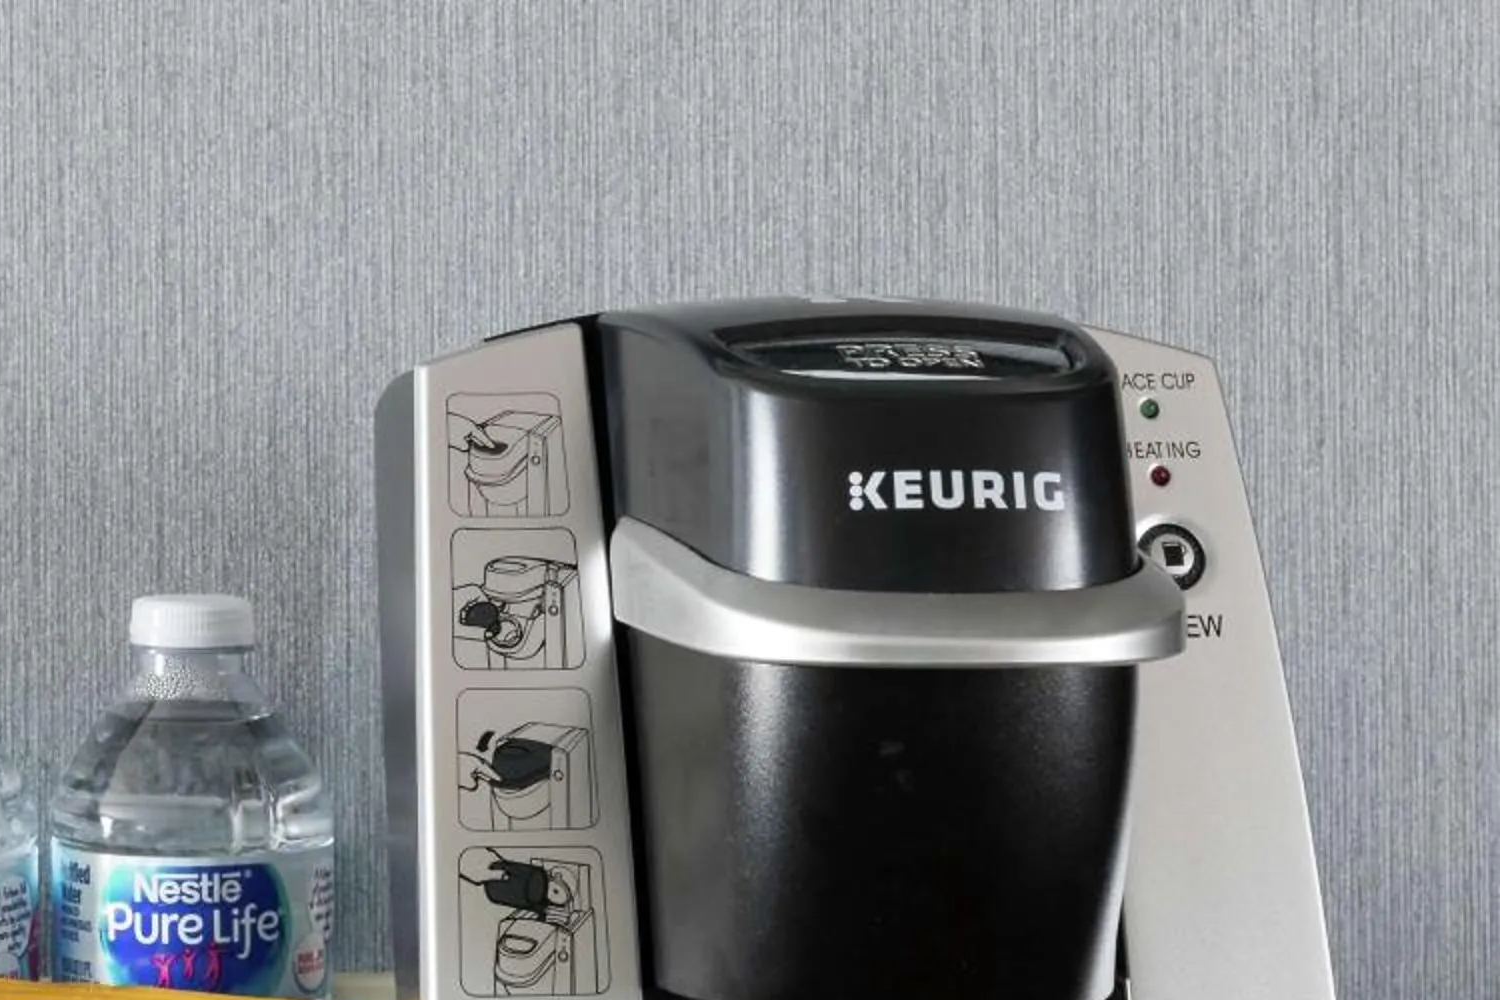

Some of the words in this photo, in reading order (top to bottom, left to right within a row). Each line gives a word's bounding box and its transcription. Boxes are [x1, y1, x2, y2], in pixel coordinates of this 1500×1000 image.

[1122, 372, 1156, 391] ACE
[1160, 372, 1196, 391] CUP
[848, 470, 1066, 512] KEURIG
[105, 902, 204, 945] Pure
[212, 903, 281, 960] Life
